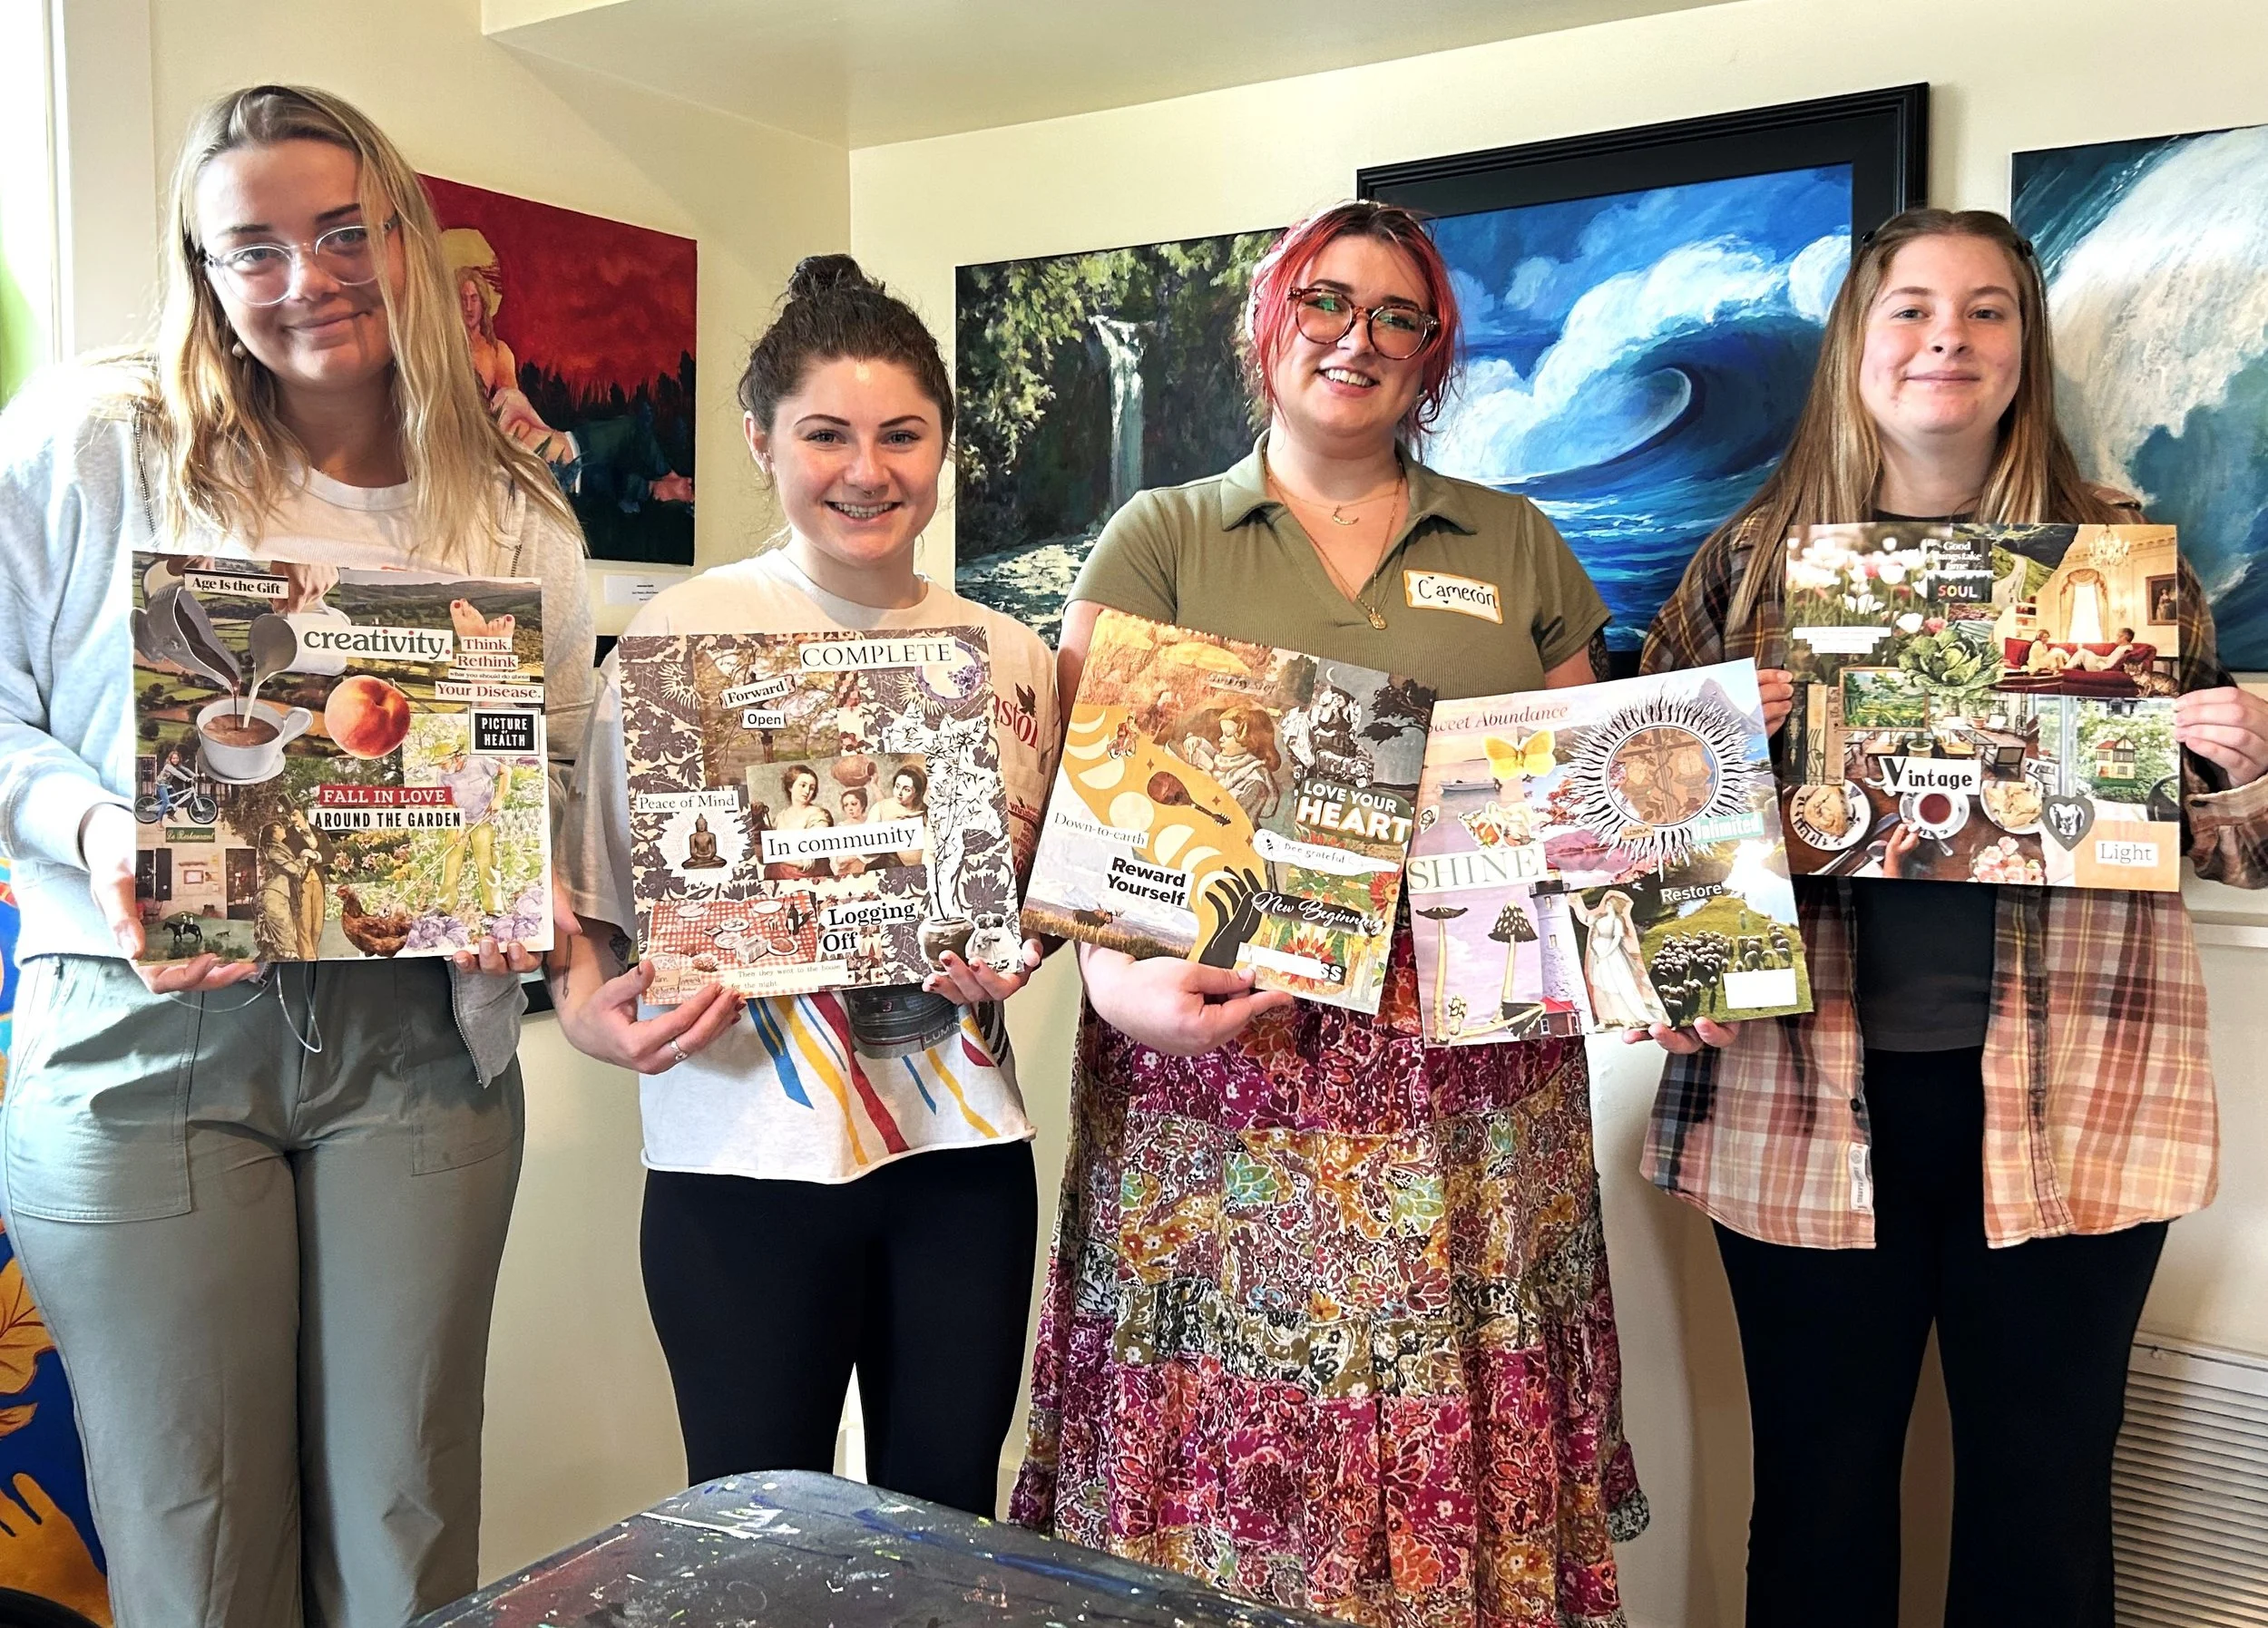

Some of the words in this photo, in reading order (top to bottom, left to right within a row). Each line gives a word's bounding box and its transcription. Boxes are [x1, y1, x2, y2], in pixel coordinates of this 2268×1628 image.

[1942, 541, 1971, 551] Good
[191, 577, 217, 591] Age
[220, 580, 231, 590] Is
[233, 580, 254, 592] the
[257, 582, 280, 594] Gift
[1418, 579, 1497, 609] Cameron
[1938, 584, 1978, 599] SOUL
[303, 629, 451, 660] creativity.
[463, 638, 512, 650] Think.
[457, 655, 517, 668] Rethink
[801, 643, 953, 667] COMPLETE
[436, 683, 472, 697] Your
[476, 686, 542, 698] Disease.
[726, 681, 786, 705] Forward
[481, 717, 528, 731] PICTURE
[747, 713, 782, 727] Open
[1475, 706, 1569, 728] Abundance
[484, 733, 526, 746] HEALTH
[1882, 757, 1973, 790] Vintage
[323, 789, 369, 804] FALL
[373, 789, 395, 804] IN
[399, 789, 446, 804] LOVE
[639, 796, 677, 810] Peace
[679, 795, 695, 808] of
[698, 794, 735, 808] Mind
[1303, 780, 1347, 803] LOVE
[1349, 790, 1398, 814] YOUR
[314, 812, 371, 828] AROUND
[376, 812, 402, 827] THE
[407, 812, 461, 827] GARDEN
[1054, 812, 1146, 845] Down-to-earth
[1295, 795, 1413, 844] HEART
[1691, 813, 1760, 840] Unlimited
[768, 838, 791, 857] In
[797, 824, 916, 853] community
[1624, 827, 1650, 836] LIBRA
[1305, 848, 1346, 864] grateful
[2099, 843, 2153, 864] Light
[1111, 856, 1187, 888] Reward
[1407, 848, 1540, 891] SHINE
[1106, 872, 1186, 906] Yourself
[1660, 883, 1723, 903] Restore
[1250, 891, 1295, 914] New
[827, 902, 916, 927] Logging
[823, 931, 858, 952] Off
[738, 970, 756, 979] Then
[758, 970, 774, 978] they
